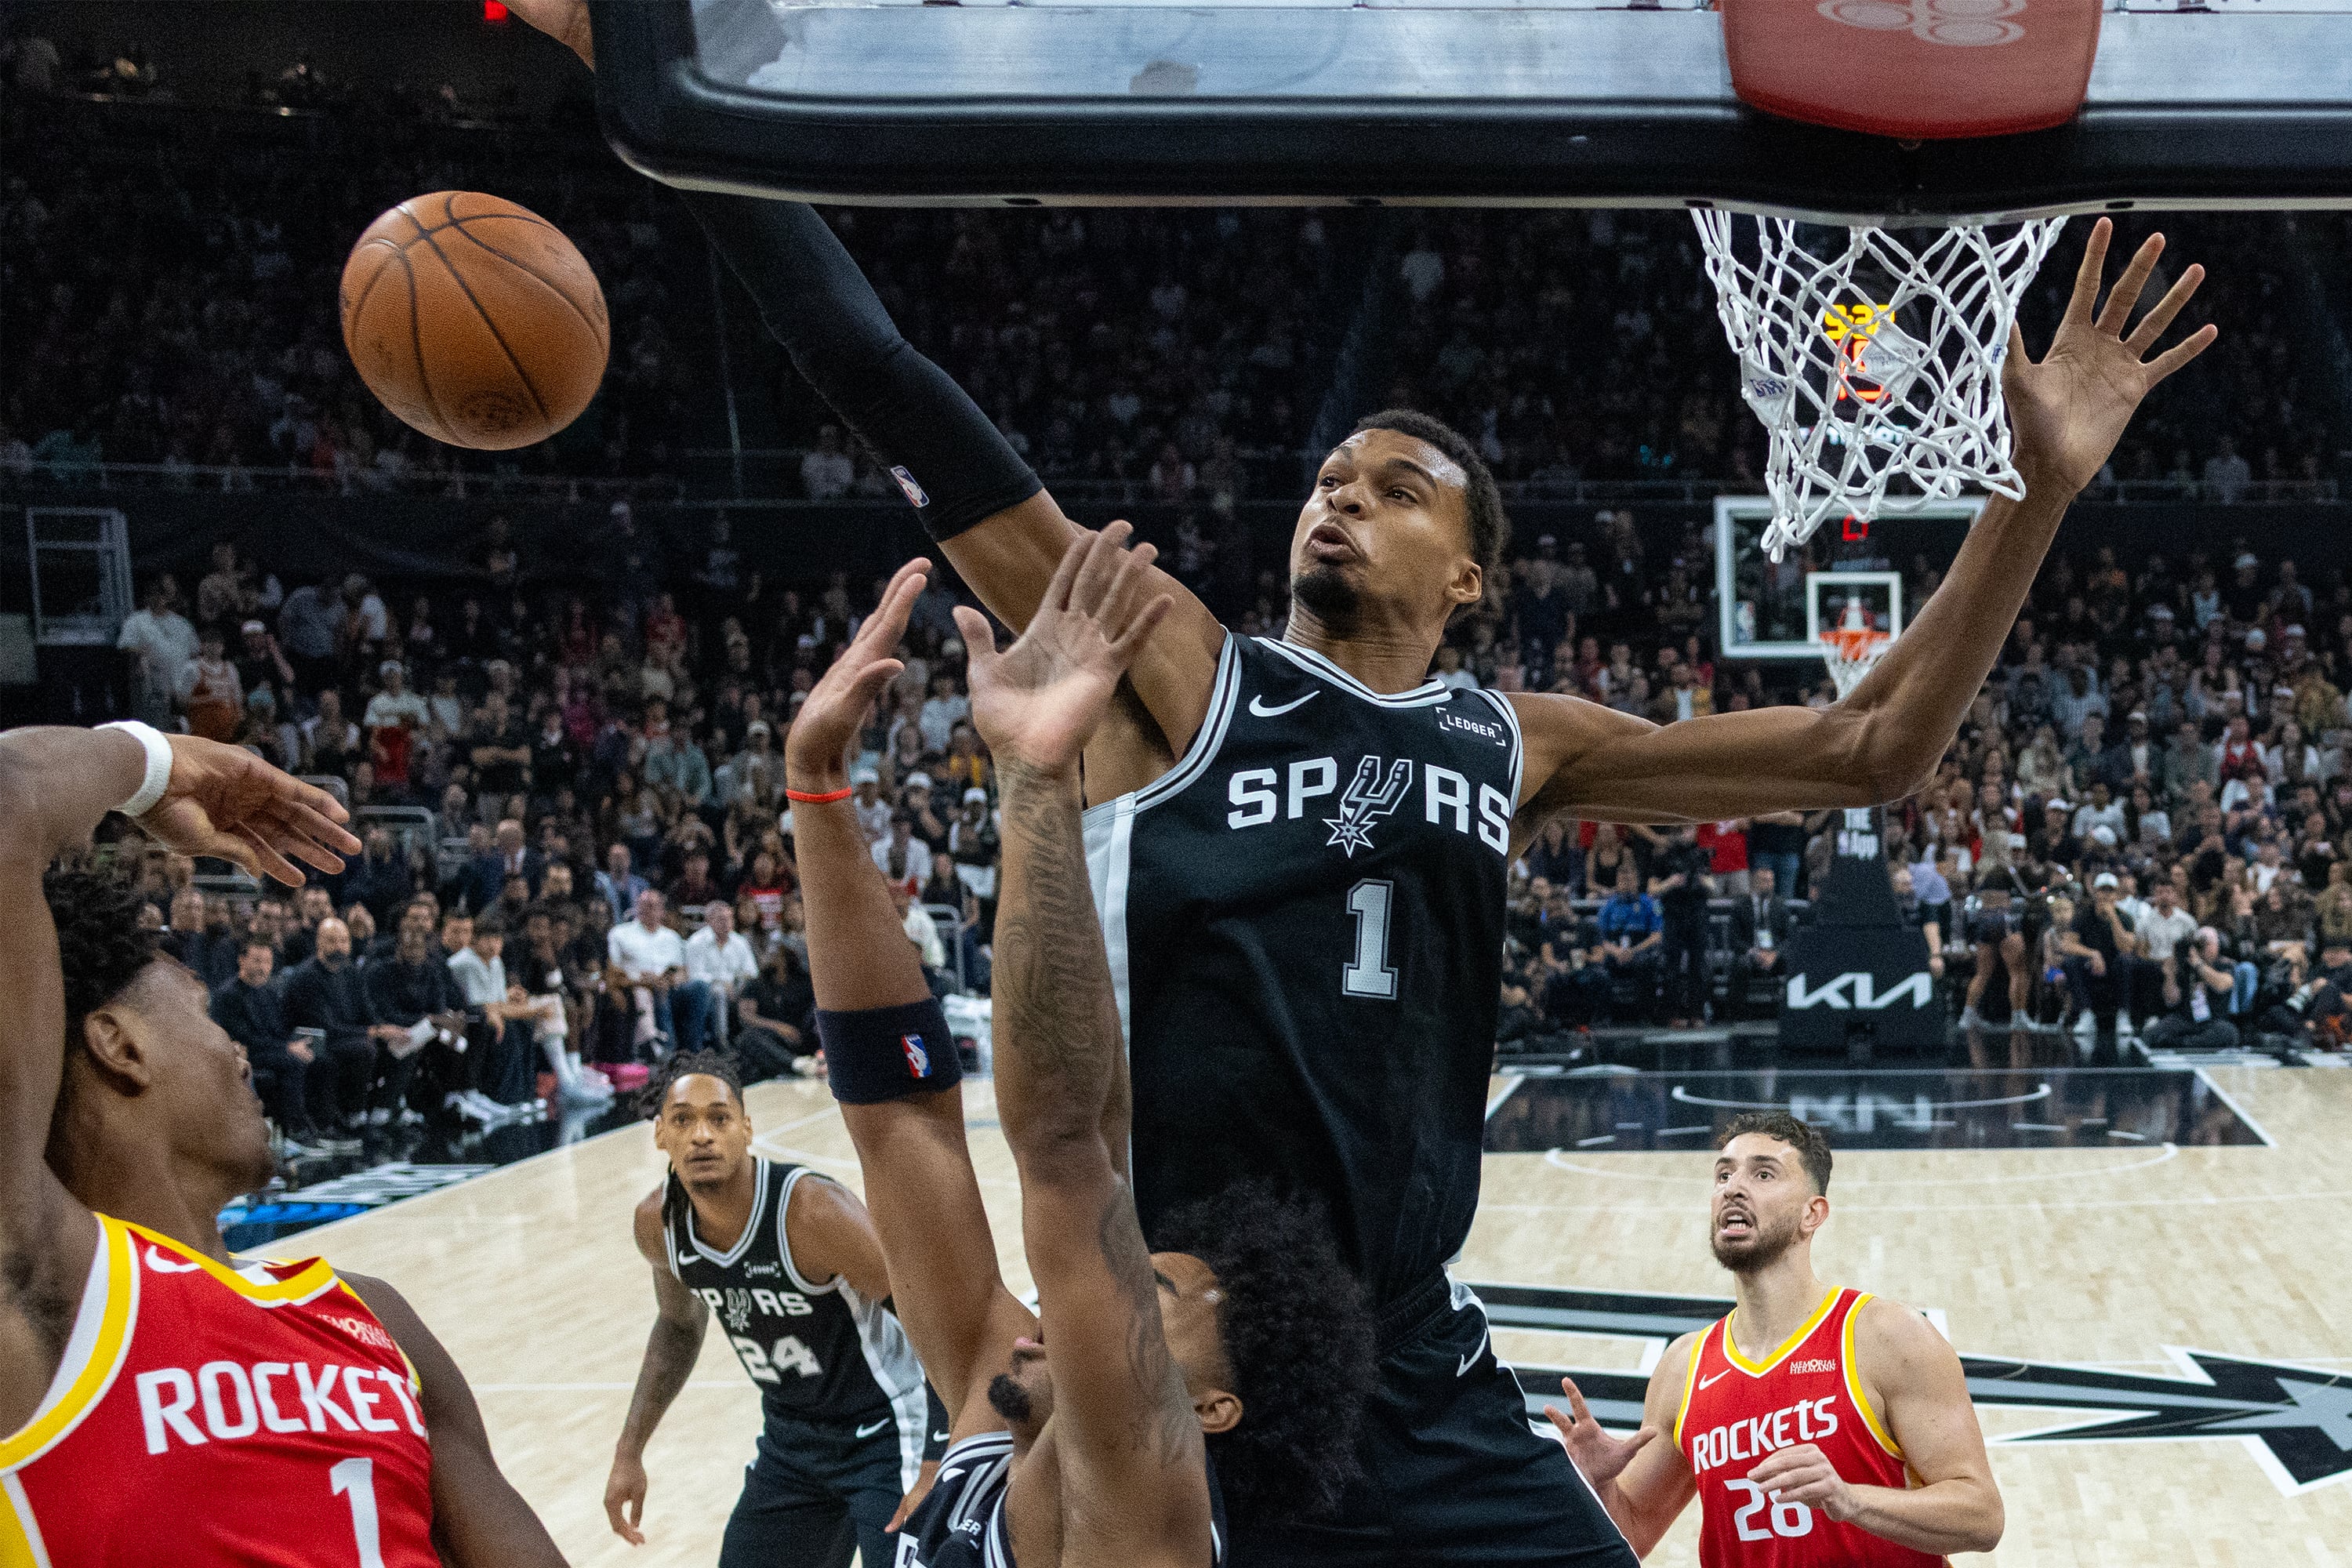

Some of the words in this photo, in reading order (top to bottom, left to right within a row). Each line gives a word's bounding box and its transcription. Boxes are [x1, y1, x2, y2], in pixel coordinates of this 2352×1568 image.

[1446, 714, 1496, 739] LEDGER
[1228, 755, 1510, 858] SPURS
[1342, 878, 1399, 1000] 1
[1787, 972, 1933, 1009] KIA
[730, 1334, 823, 1385] 24
[1790, 1363, 1836, 1374] HERMANN
[1791, 1358, 1835, 1369] MEMORIAL
[136, 1360, 429, 1456] ROCKET
[1693, 1395, 1838, 1475] ROCKETS
[329, 1457, 386, 1568] 1
